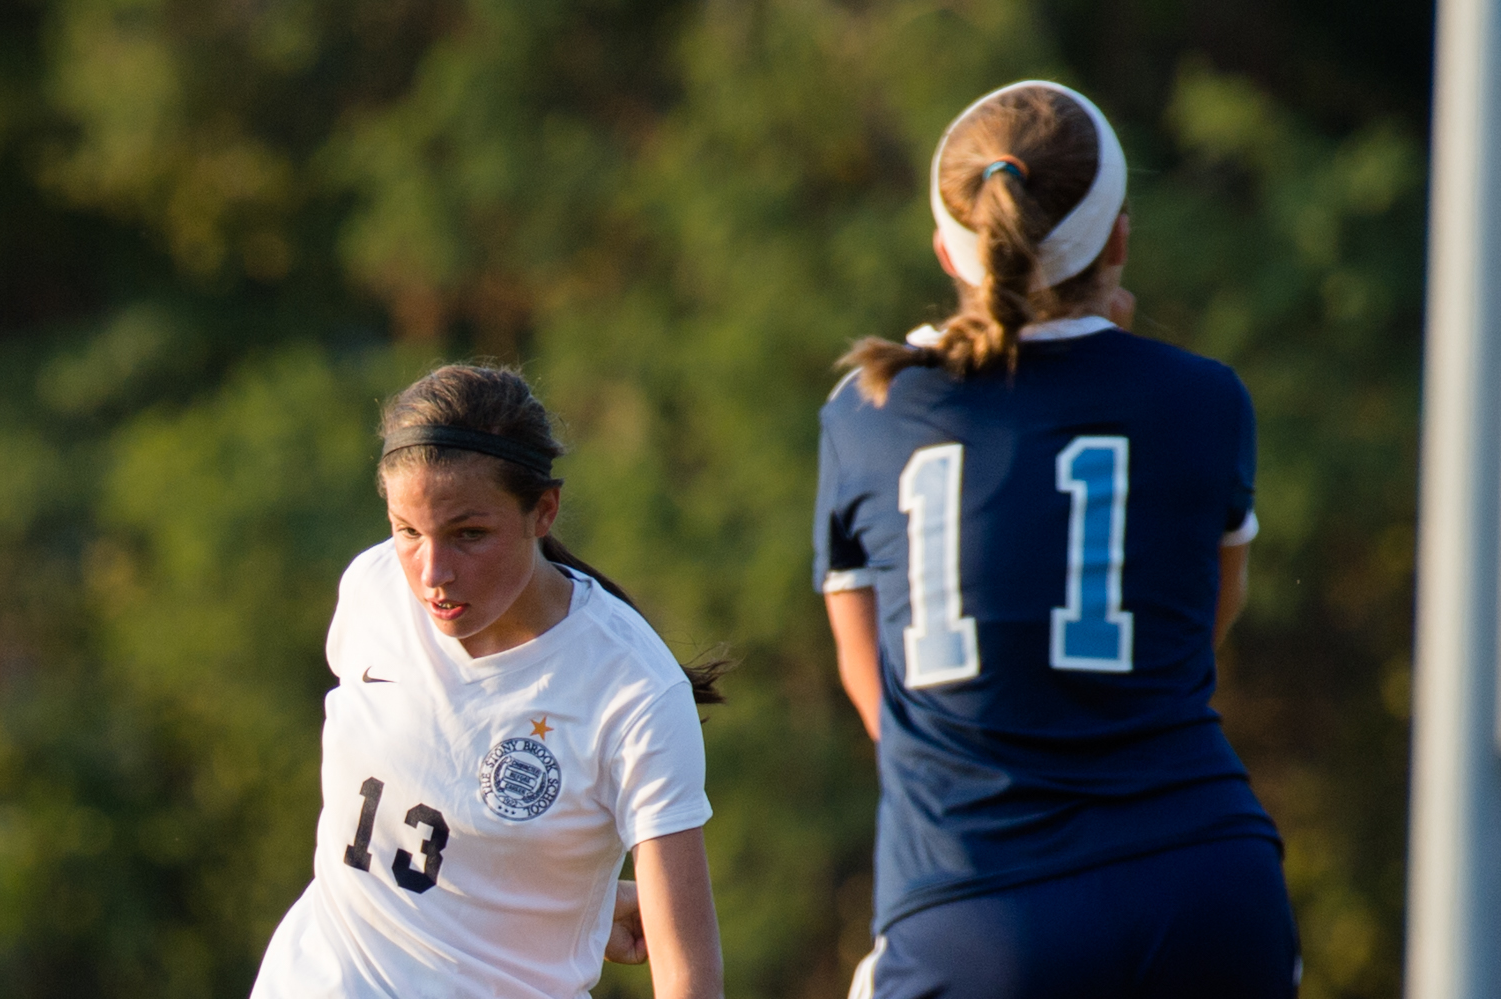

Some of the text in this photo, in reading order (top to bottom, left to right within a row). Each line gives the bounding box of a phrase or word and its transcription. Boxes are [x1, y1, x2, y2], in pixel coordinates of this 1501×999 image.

[898, 435, 1134, 690] 11
[343, 776, 450, 894] 13
[482, 740, 559, 816] THE STONY BROOK SCHOOL
